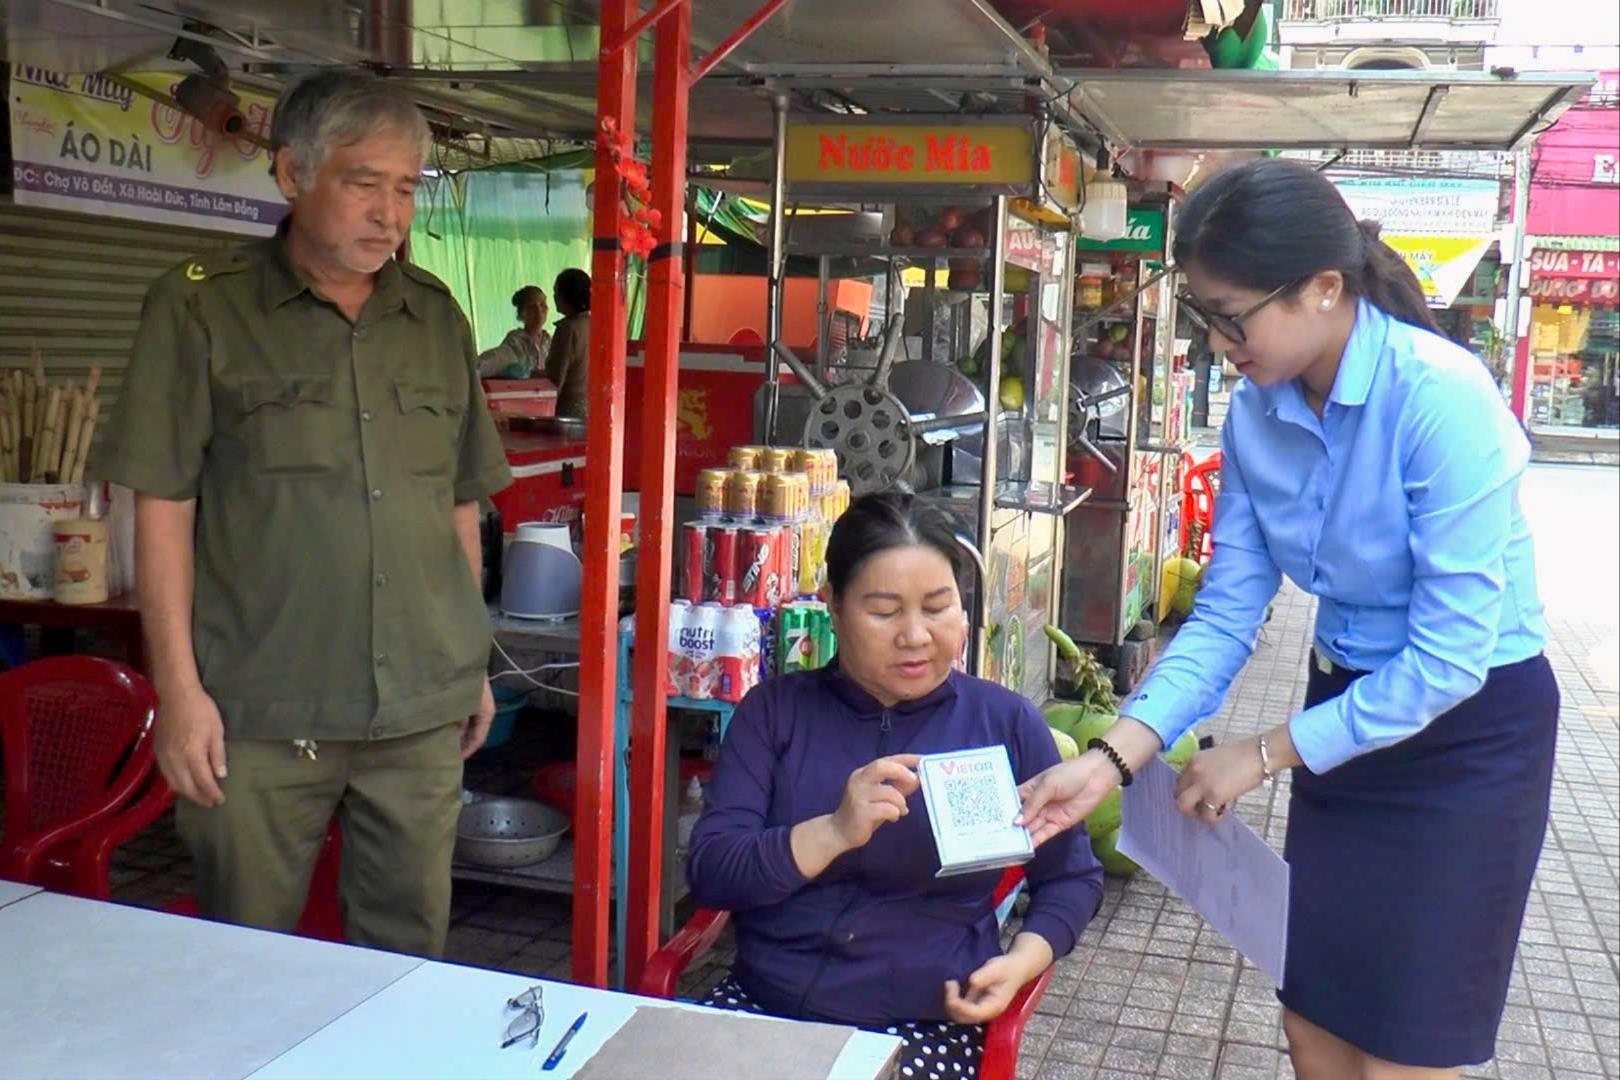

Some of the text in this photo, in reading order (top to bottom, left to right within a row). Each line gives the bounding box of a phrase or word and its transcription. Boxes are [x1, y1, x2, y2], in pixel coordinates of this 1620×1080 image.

[60, 120, 101, 163] ÁO
[108, 133, 151, 172] DÀI
[743, 543, 770, 592] STING
[680, 626, 714, 638] nutri
[680, 635, 715, 650] boost
